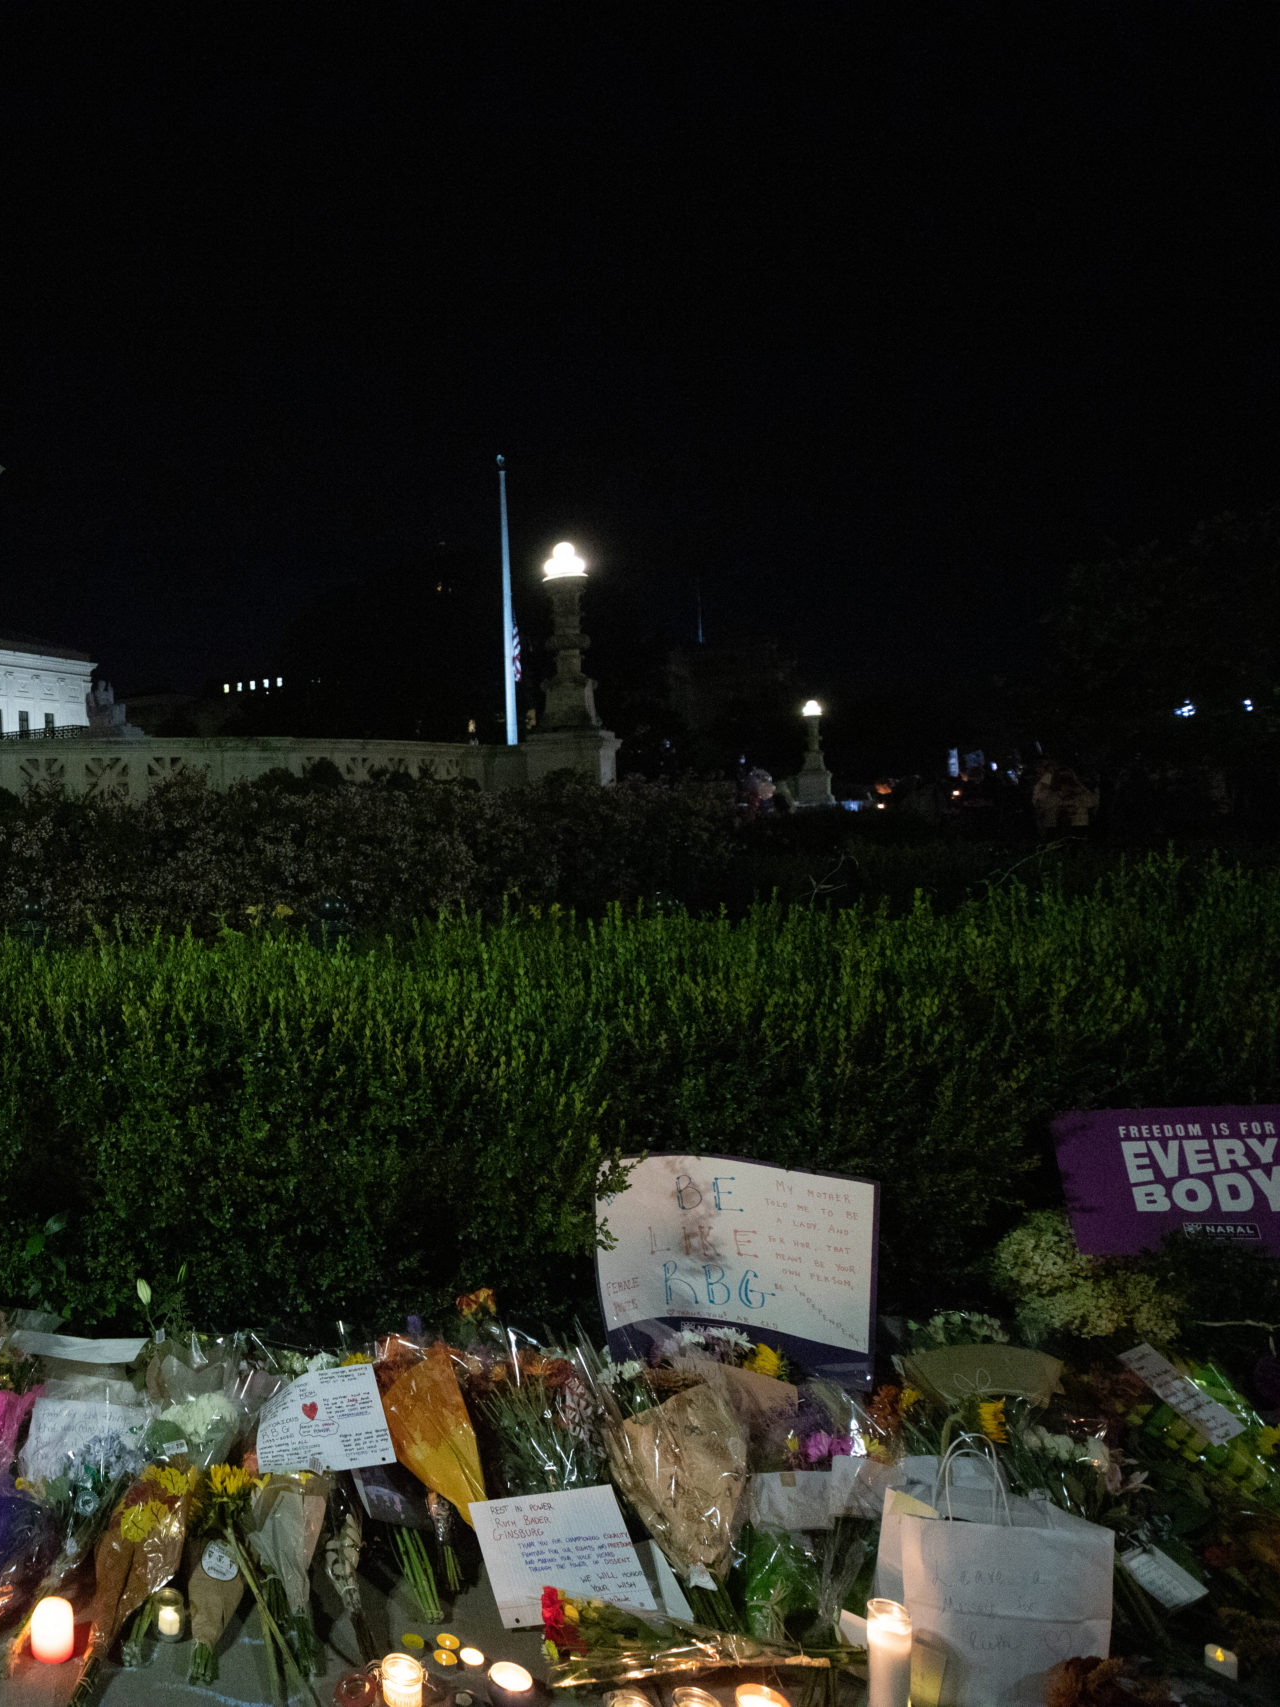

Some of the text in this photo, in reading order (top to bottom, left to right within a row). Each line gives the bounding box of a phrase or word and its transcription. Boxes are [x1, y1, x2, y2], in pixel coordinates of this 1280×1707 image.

[1118, 1121, 1276, 1138] FREEDOM IS FOR
[1121, 1137, 1278, 1184] EVERY
[675, 1174, 744, 1213] BE
[807, 1189, 852, 1204] MOTHER
[1131, 1165, 1280, 1213] BODY
[764, 1198, 859, 1221] TOLD ME TO BE
[828, 1224, 850, 1236] AND
[1205, 1225, 1254, 1234] NARAL
[662, 1259, 777, 1310] RBG
[490, 1502, 554, 1515] REST IN POWER
[523, 1515, 552, 1527] BADER
[493, 1527, 545, 1542] GINSBURG
[603, 1556, 631, 1566] DISSENT
[580, 1574, 592, 1584] WE
[597, 1570, 618, 1581] WILL
[590, 1581, 637, 1593] YOUR WISH
